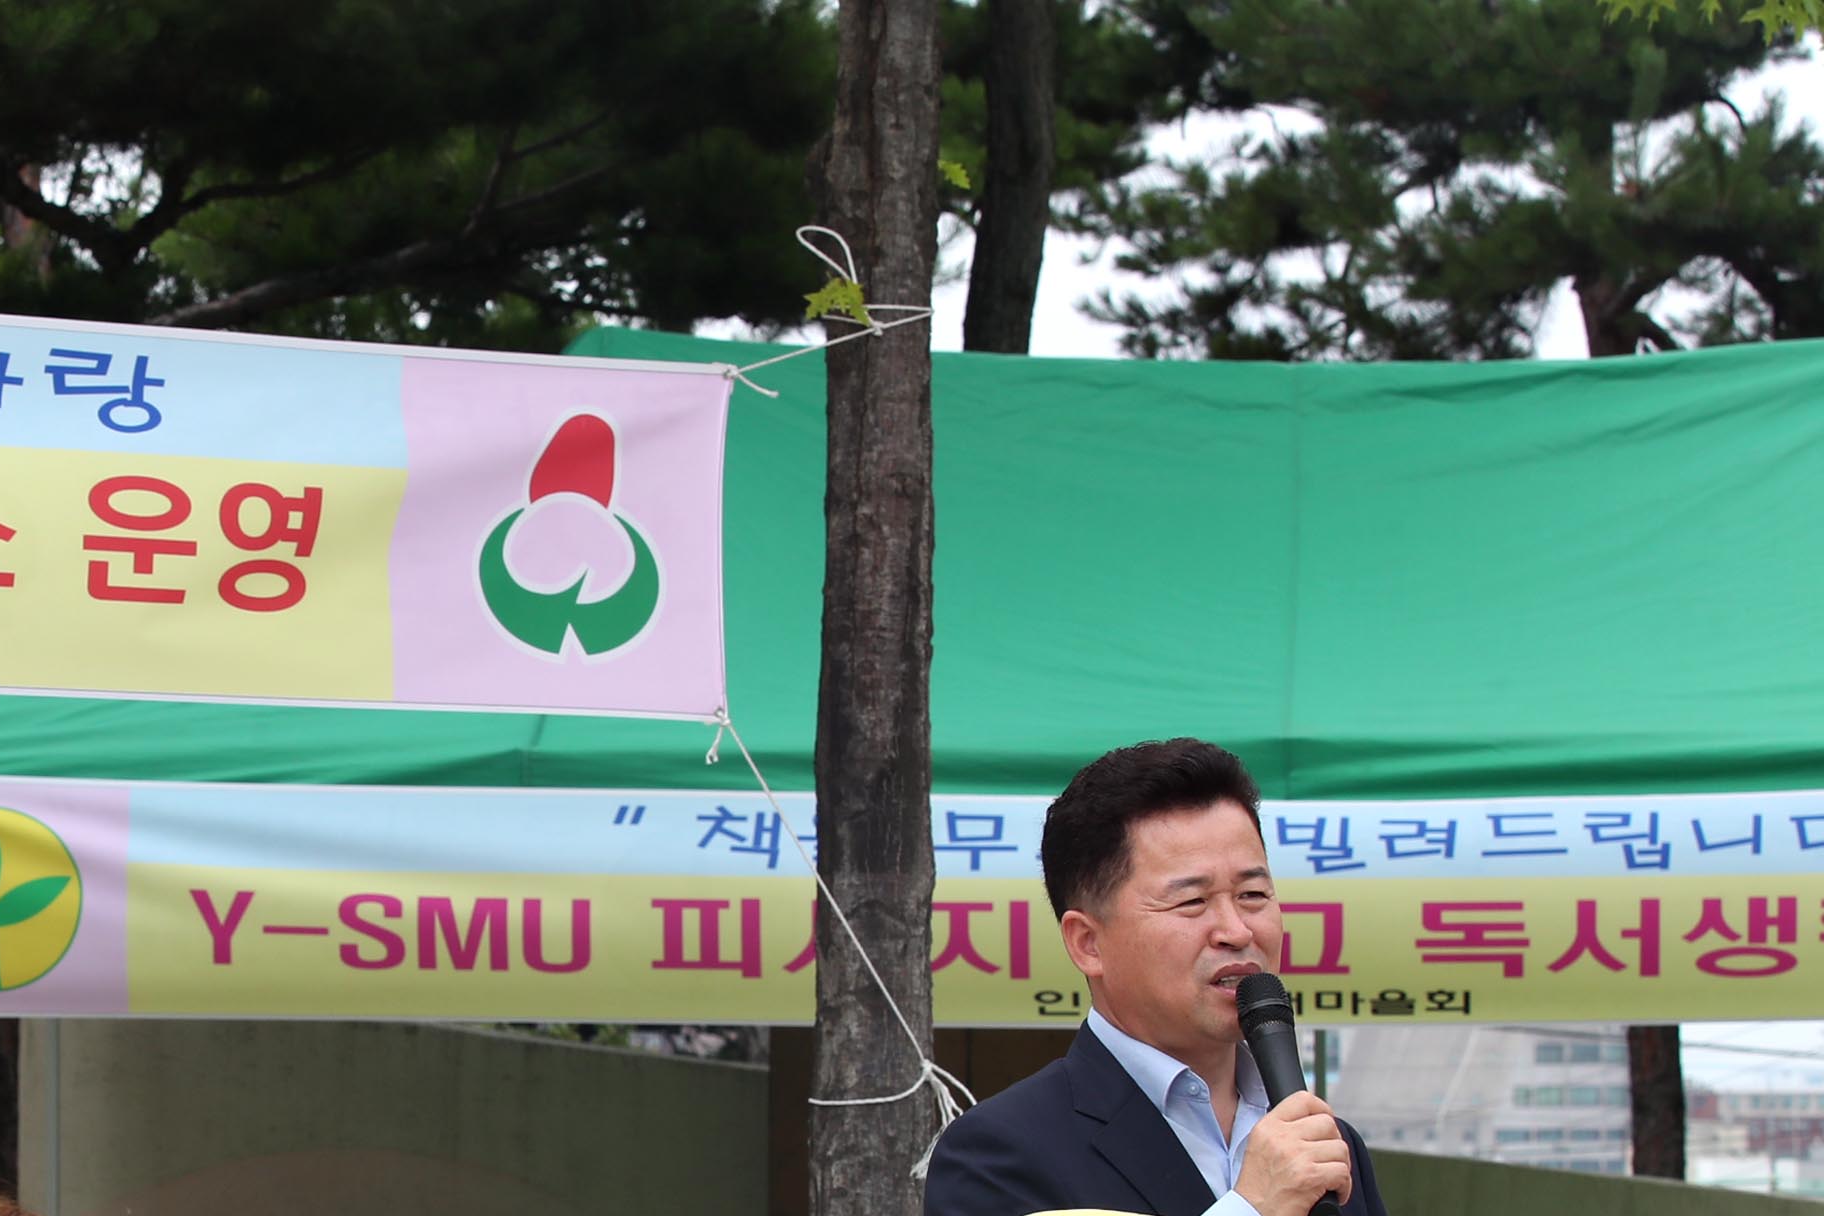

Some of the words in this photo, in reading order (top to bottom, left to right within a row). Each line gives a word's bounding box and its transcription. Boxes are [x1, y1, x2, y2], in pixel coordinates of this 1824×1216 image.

[83, 474, 324, 613] 운영
[696, 805, 818, 870] 책
[1415, 896, 1824, 979] 독서생
